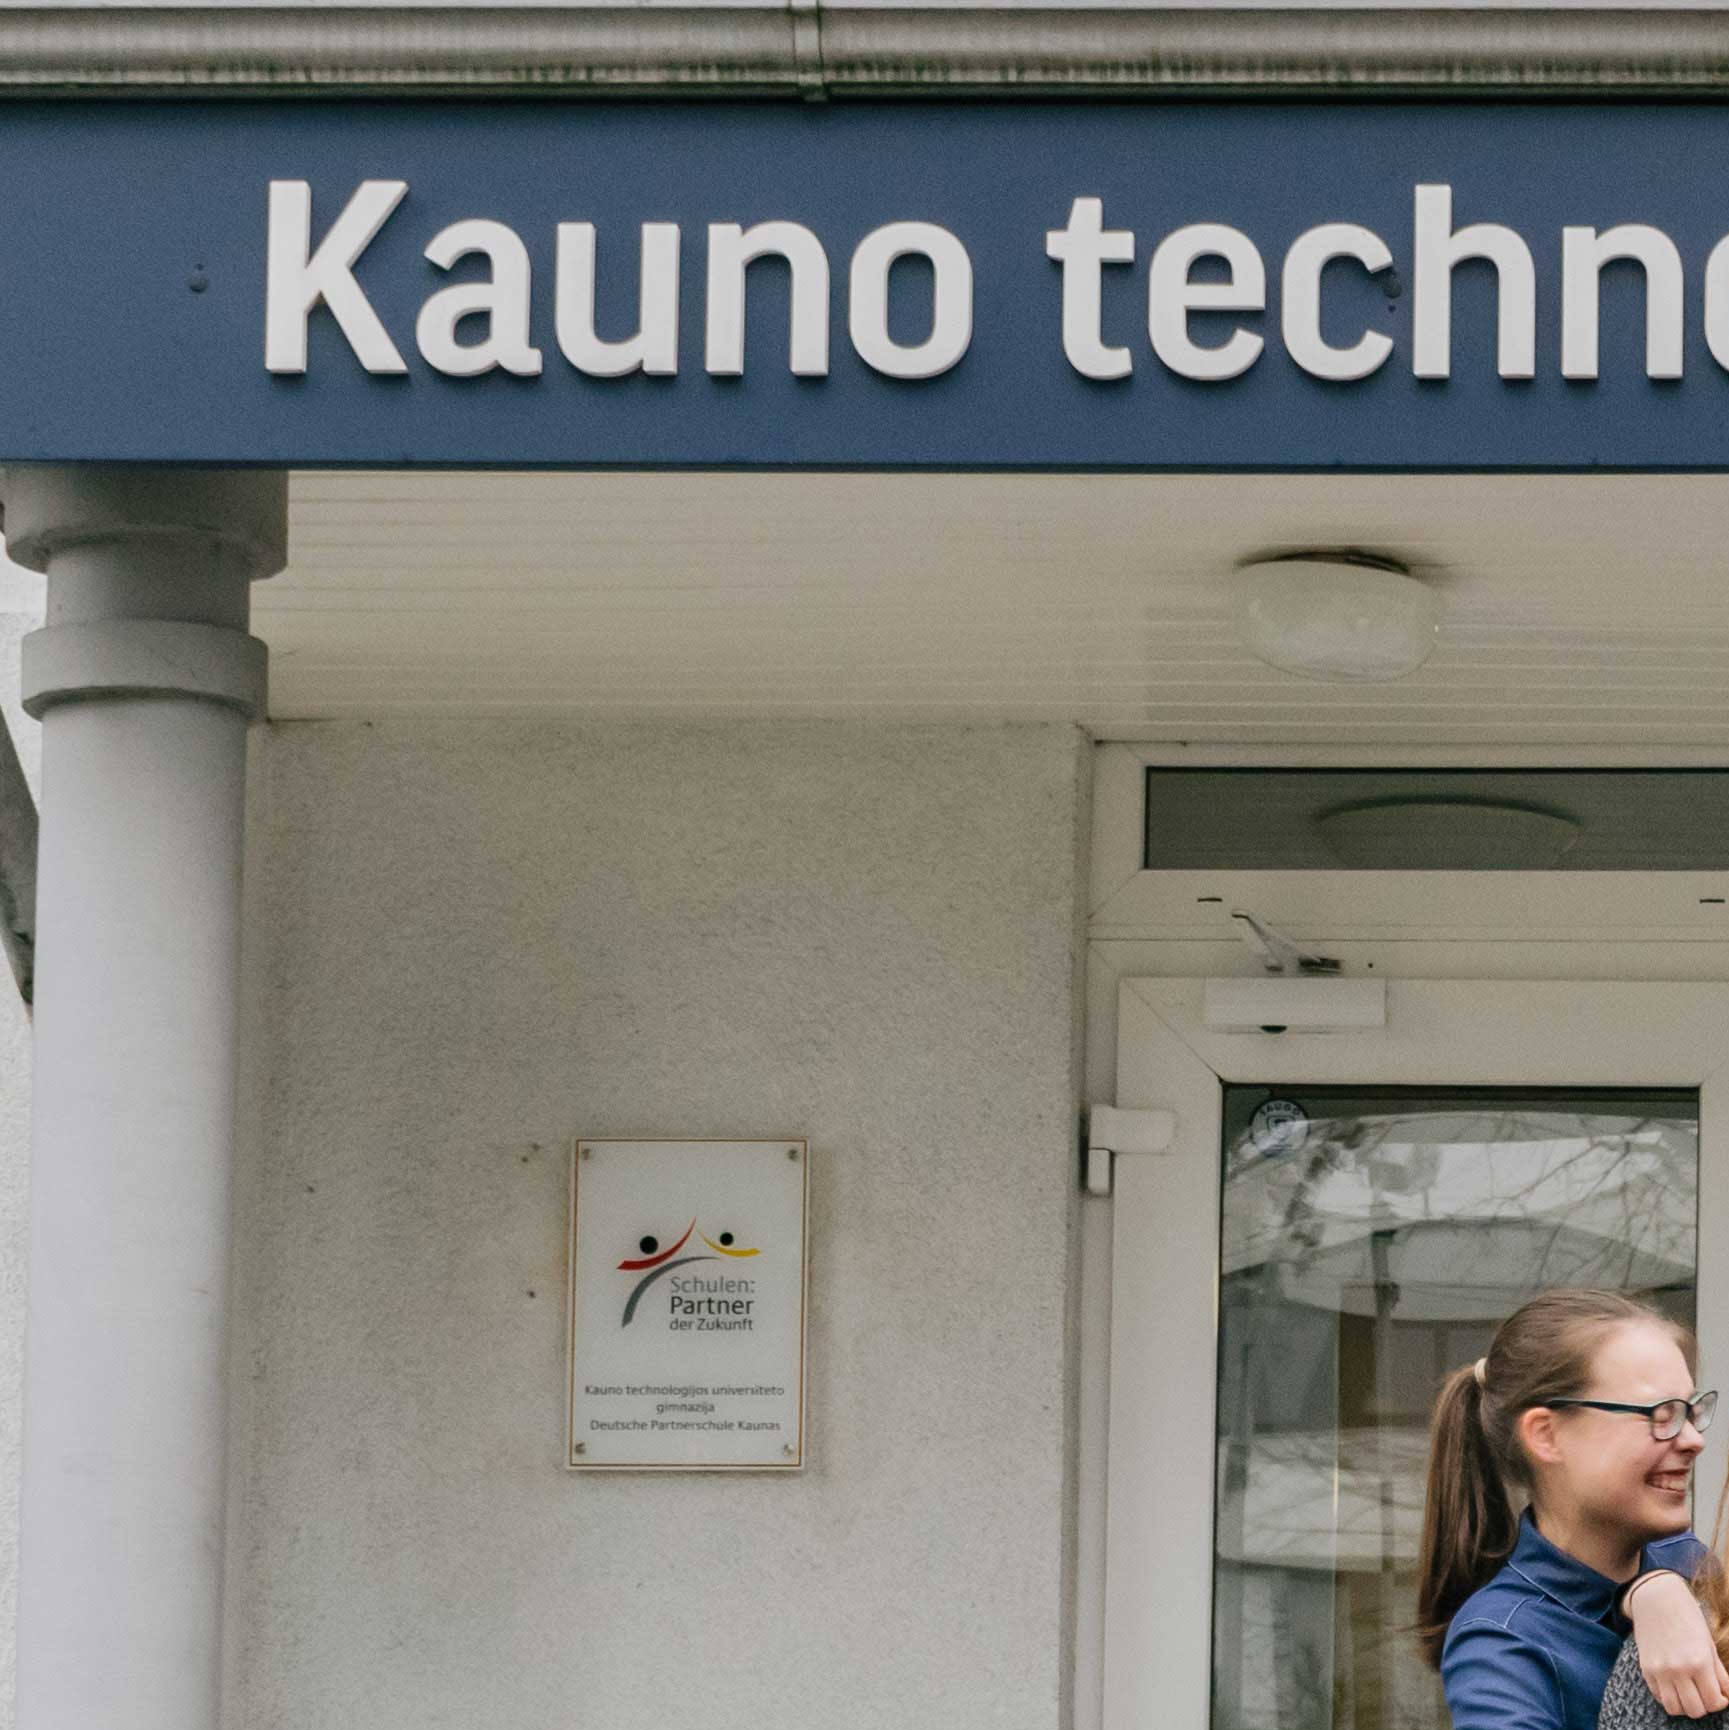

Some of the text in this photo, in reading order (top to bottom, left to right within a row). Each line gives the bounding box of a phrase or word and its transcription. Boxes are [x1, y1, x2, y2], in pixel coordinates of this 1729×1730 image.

[264, 179, 975, 378] Kauno
[670, 1275, 755, 1293] Schulen:
[670, 1296, 755, 1315] Partner
[669, 1317, 753, 1331] der Zukunft
[584, 1384, 784, 1398] Kauno technologijos universiteto
[656, 1401, 715, 1415] gimnazija
[590, 1419, 781, 1431] Deutsche Partnerschule Kaunas
